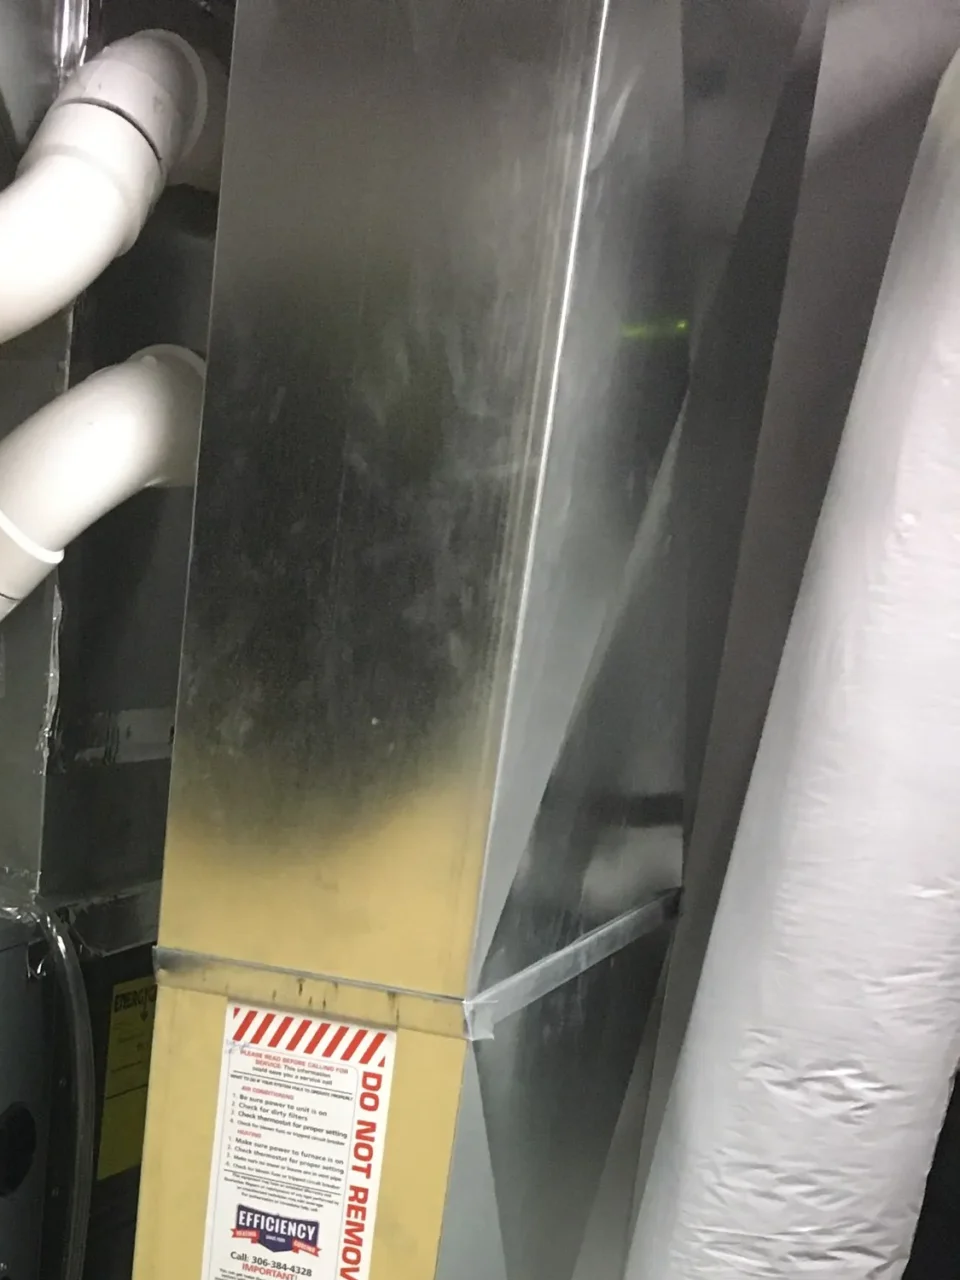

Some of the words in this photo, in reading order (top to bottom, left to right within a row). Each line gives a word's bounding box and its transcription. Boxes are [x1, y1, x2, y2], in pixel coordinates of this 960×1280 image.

[282, 1057, 305, 1065] BEFORE
[307, 1062, 334, 1070] CALLING
[296, 1067, 330, 1077] information
[299, 1075, 320, 1083] service
[251, 1087, 293, 1100] CONDITIONING
[358, 1070, 382, 1112] DO
[238, 1102, 257, 1110] Check
[270, 1108, 286, 1118] dirty
[288, 1111, 308, 1121] filters
[264, 1100, 286, 1108] power
[236, 1128, 261, 1138] HEATING
[237, 1110, 255, 1118] Check
[257, 1114, 290, 1126] thermostat
[302, 1124, 324, 1133] proper
[325, 1128, 347, 1139] setting
[234, 1145, 252, 1153] Check
[253, 1150, 287, 1161] thermostat
[299, 1160, 320, 1169] proper
[322, 1164, 344, 1174] setting
[235, 1137, 252, 1145] Make
[269, 1145, 290, 1154] power
[300, 1150, 326, 1161] furnace
[350, 1119, 376, 1179] NOT
[238, 1209, 316, 1241] EFFICIENCY
[230, 1250, 249, 1262] Call:
[251, 1255, 312, 1277] 306-384-4328
